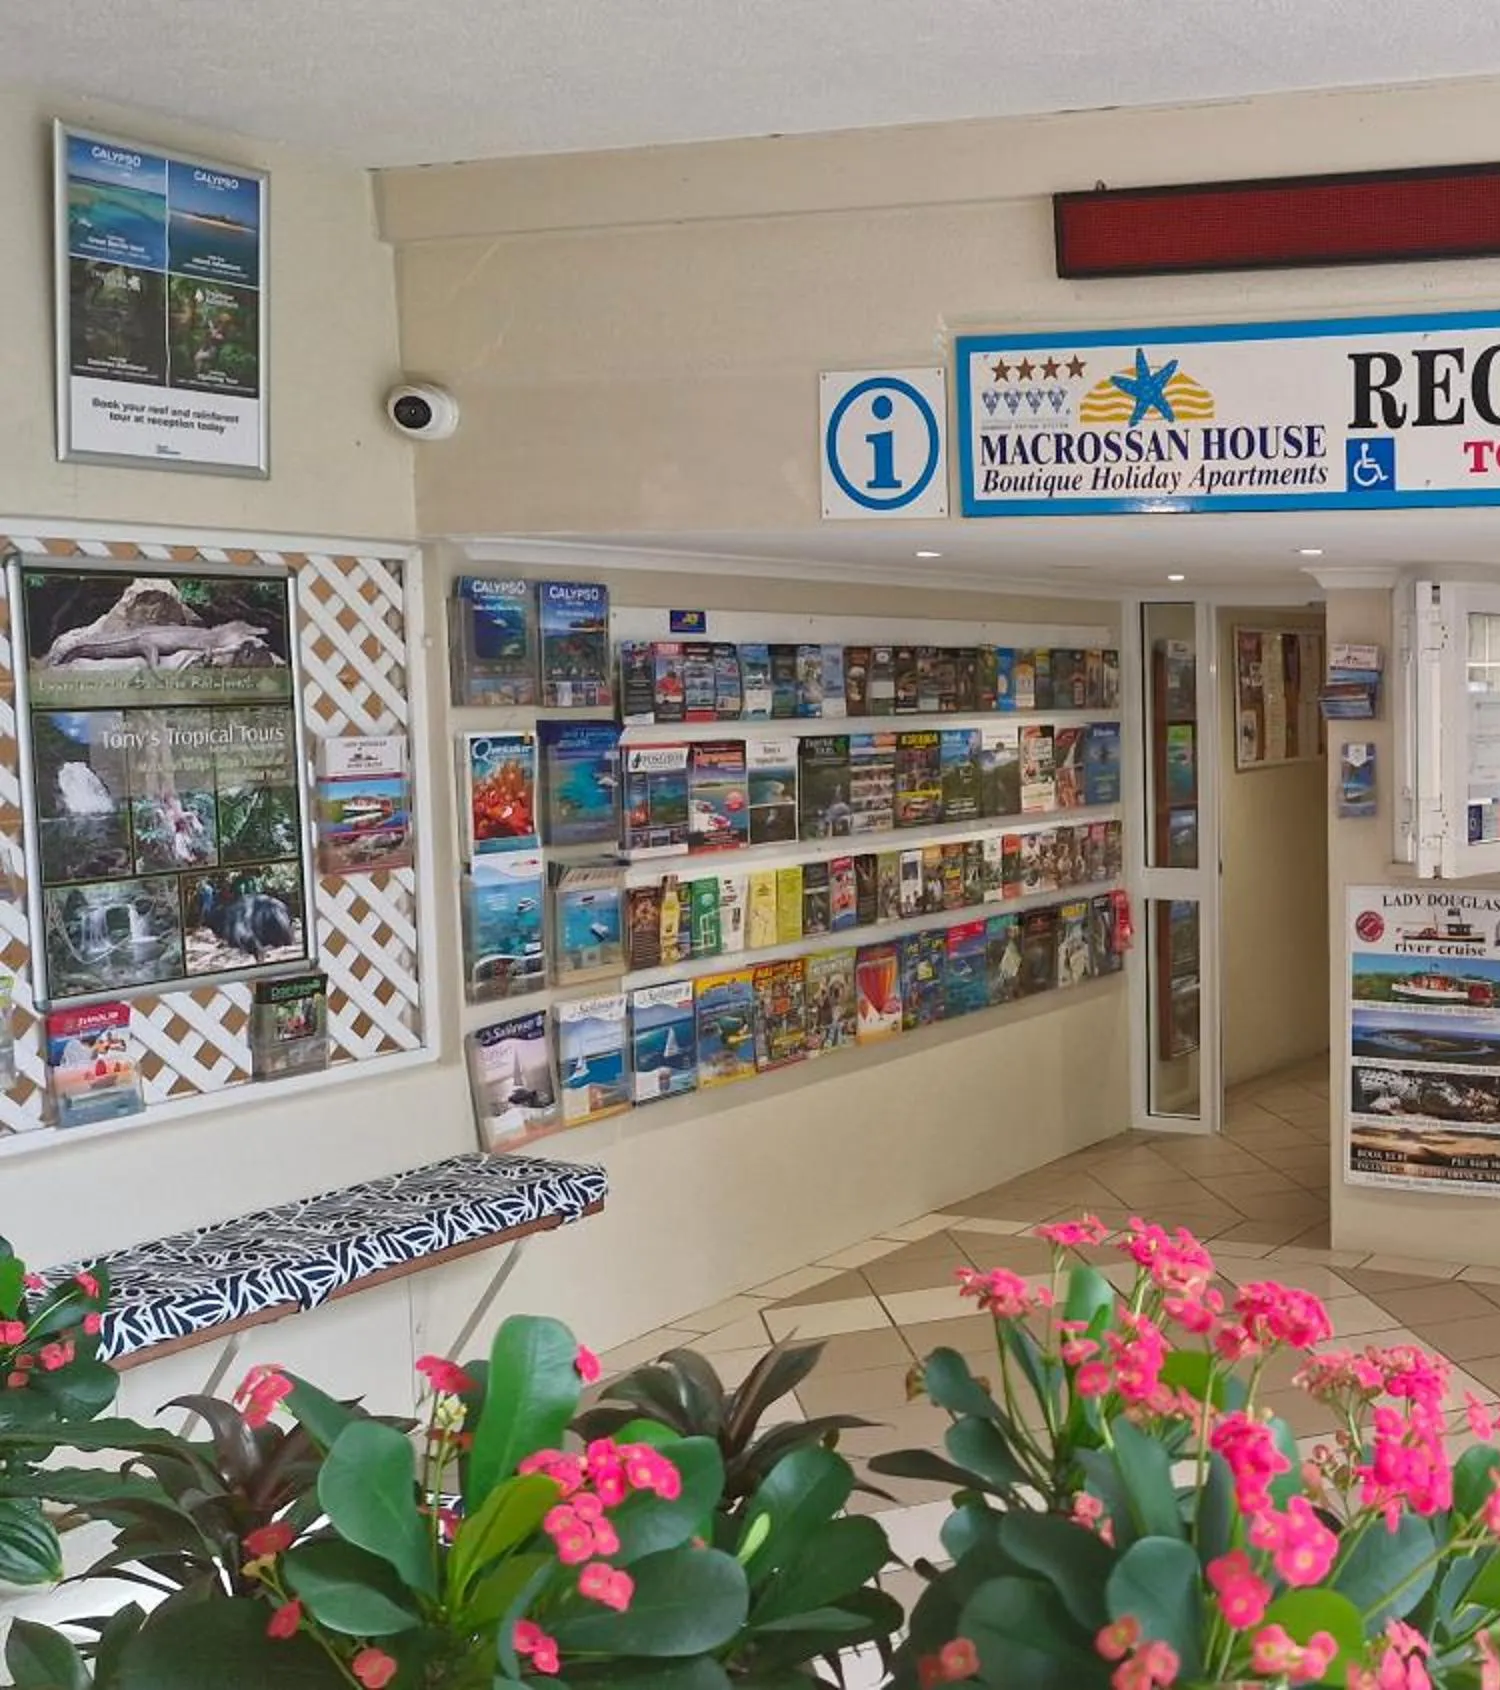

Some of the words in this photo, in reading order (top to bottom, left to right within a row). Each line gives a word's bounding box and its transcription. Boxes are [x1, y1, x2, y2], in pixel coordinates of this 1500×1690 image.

[91, 146, 141, 167] CALYPSO
[193, 170, 239, 189] CALYPSO
[92, 397, 120, 409] Book
[121, 402, 146, 413] your
[171, 407, 191, 418] and
[109, 412, 131, 422] tour
[134, 415, 145, 424] at
[147, 417, 195, 431] reception
[197, 421, 225, 434] today
[980, 429, 1190, 466] MACROSSAN
[1202, 425, 1328, 461] HOUSE
[982, 467, 1083, 498] Boutique
[1090, 466, 1182, 495] Holiday
[1189, 462, 1329, 491] Apartments
[472, 579, 527, 595] CALYPSO
[549, 586, 599, 600] CALYPSO
[99, 728, 160, 750] Tony's
[165, 724, 234, 748] Tropical
[239, 723, 285, 742] Tours
[1383, 894, 1424, 907] LADY
[1395, 943, 1436, 954] river
[1437, 944, 1487, 957] cruise
